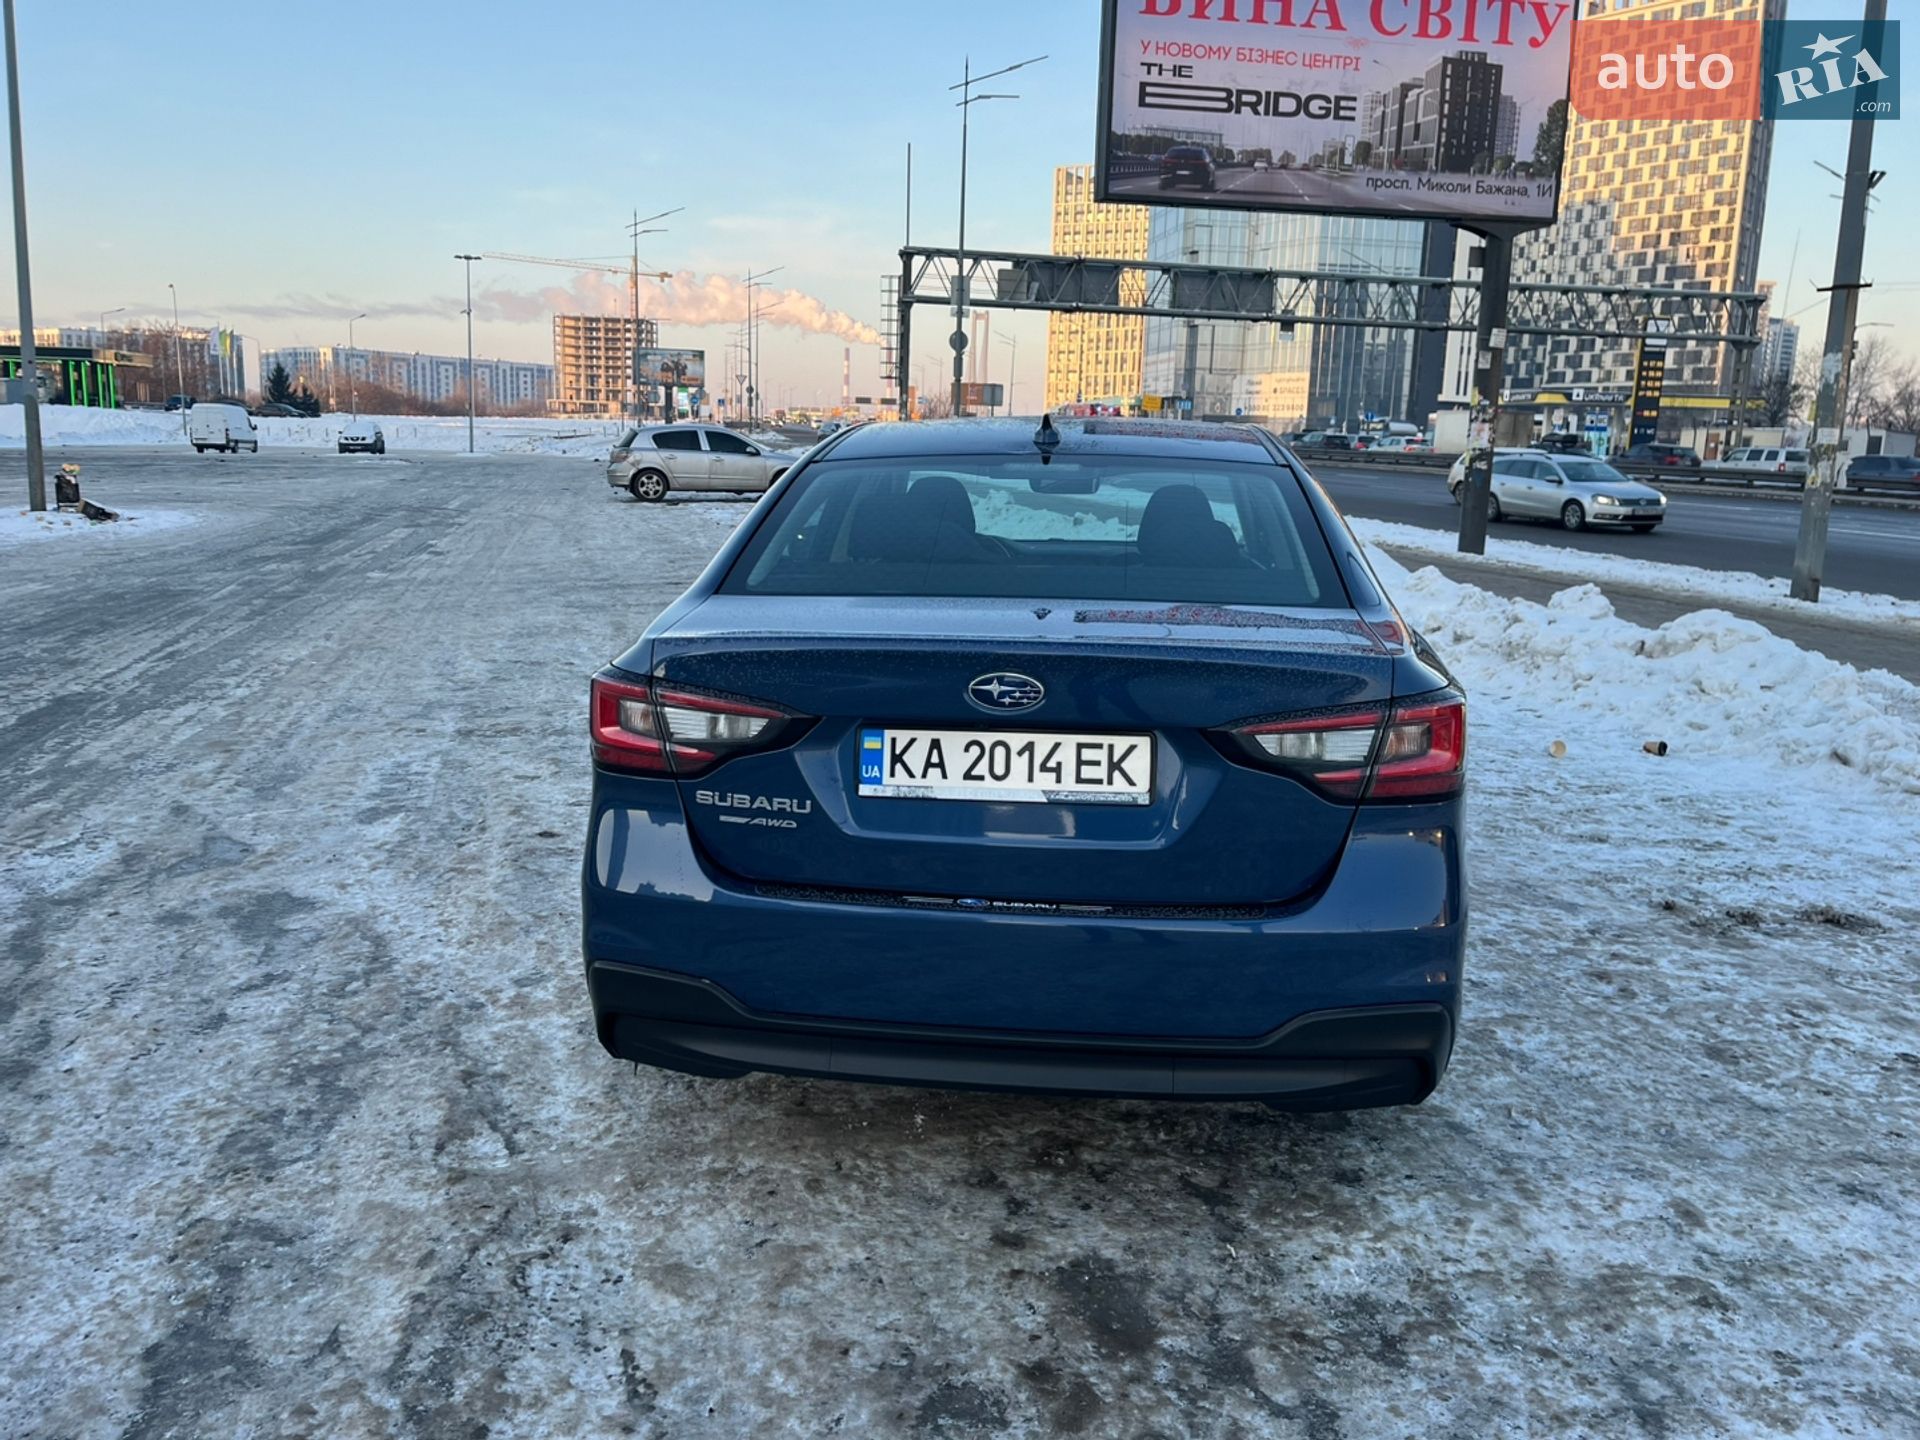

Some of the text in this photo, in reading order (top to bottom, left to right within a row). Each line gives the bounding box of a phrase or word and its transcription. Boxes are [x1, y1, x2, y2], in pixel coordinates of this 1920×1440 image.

[1369, 0, 1570, 48] СВІТУ
[1140, 39, 1361, 71] У НОВОМУ БІЗНЕС ЦЕНТРІ
[1140, 62, 1193, 79] THE
[1137, 81, 1358, 121] BRIDGE
[1366, 176, 1412, 192] просп.
[1417, 177, 1471, 194] Миколи
[862, 765, 881, 778] UA
[889, 737, 1139, 787] KA 2014 EK
[695, 790, 812, 814] SUBARU
[748, 818, 798, 828] AWD
[992, 901, 1057, 909] SUBARU
